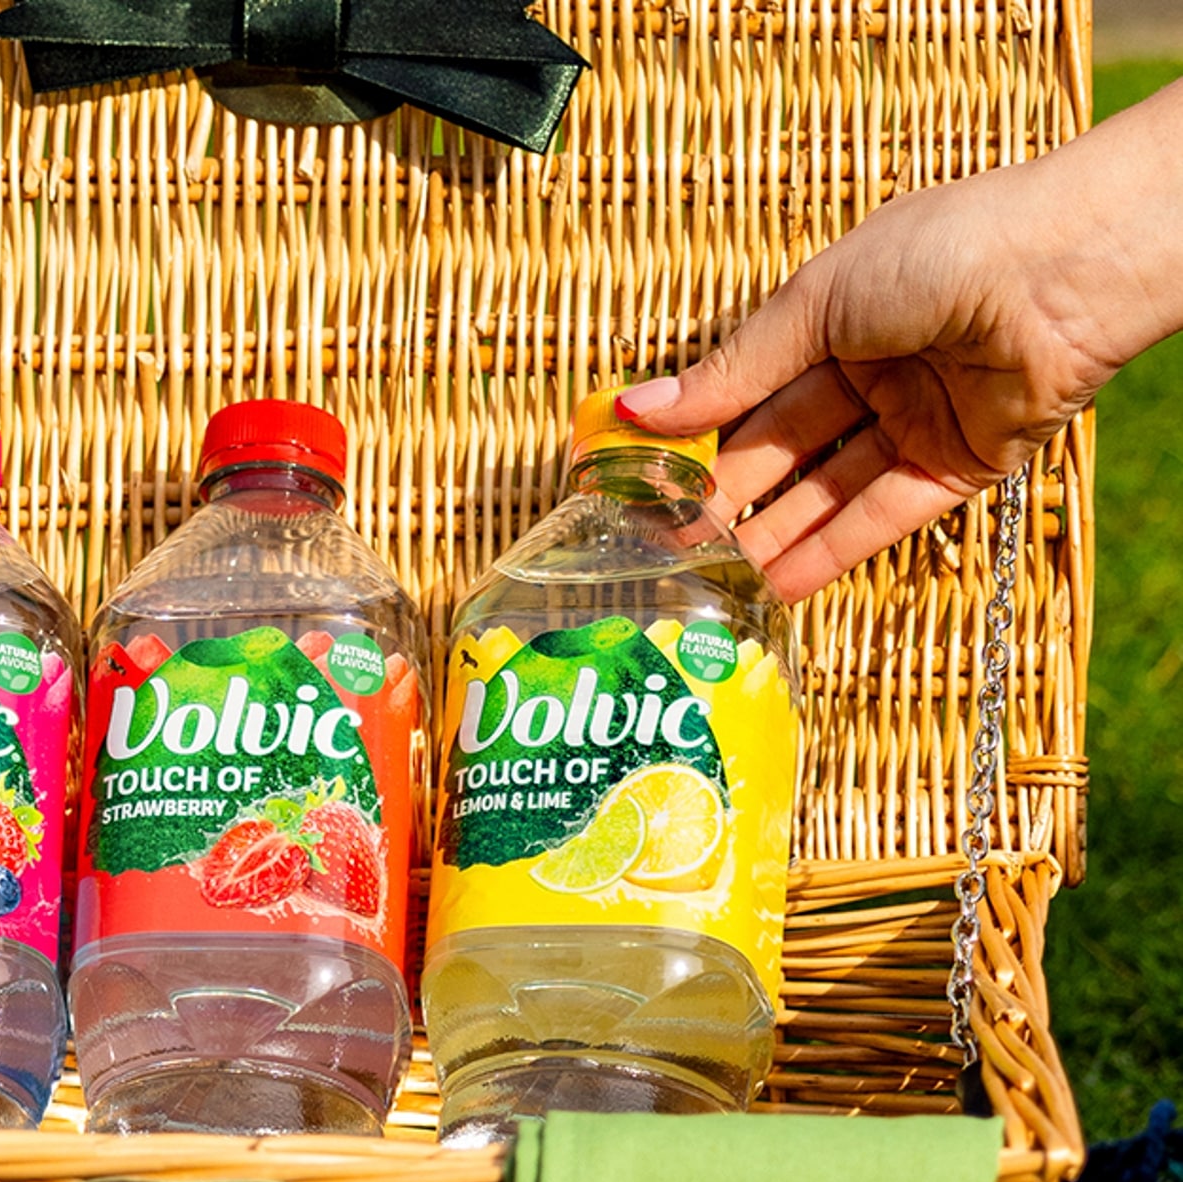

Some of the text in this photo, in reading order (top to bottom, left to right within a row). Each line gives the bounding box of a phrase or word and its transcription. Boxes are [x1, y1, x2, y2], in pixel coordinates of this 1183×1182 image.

[334, 643, 383, 664] NATURAL
[680, 642, 736, 664] FLAVOURS
[683, 631, 735, 652] NATURAL
[331, 653, 384, 677] FLAVOURS
[106, 676, 362, 760] Volvic
[458, 667, 711, 753] Volvic
[103, 766, 263, 799] TOUCH OF
[455, 757, 610, 790] TOUCH OF
[102, 799, 228, 824] STRAWBERRY
[453, 791, 572, 819] LEMON & LIME
